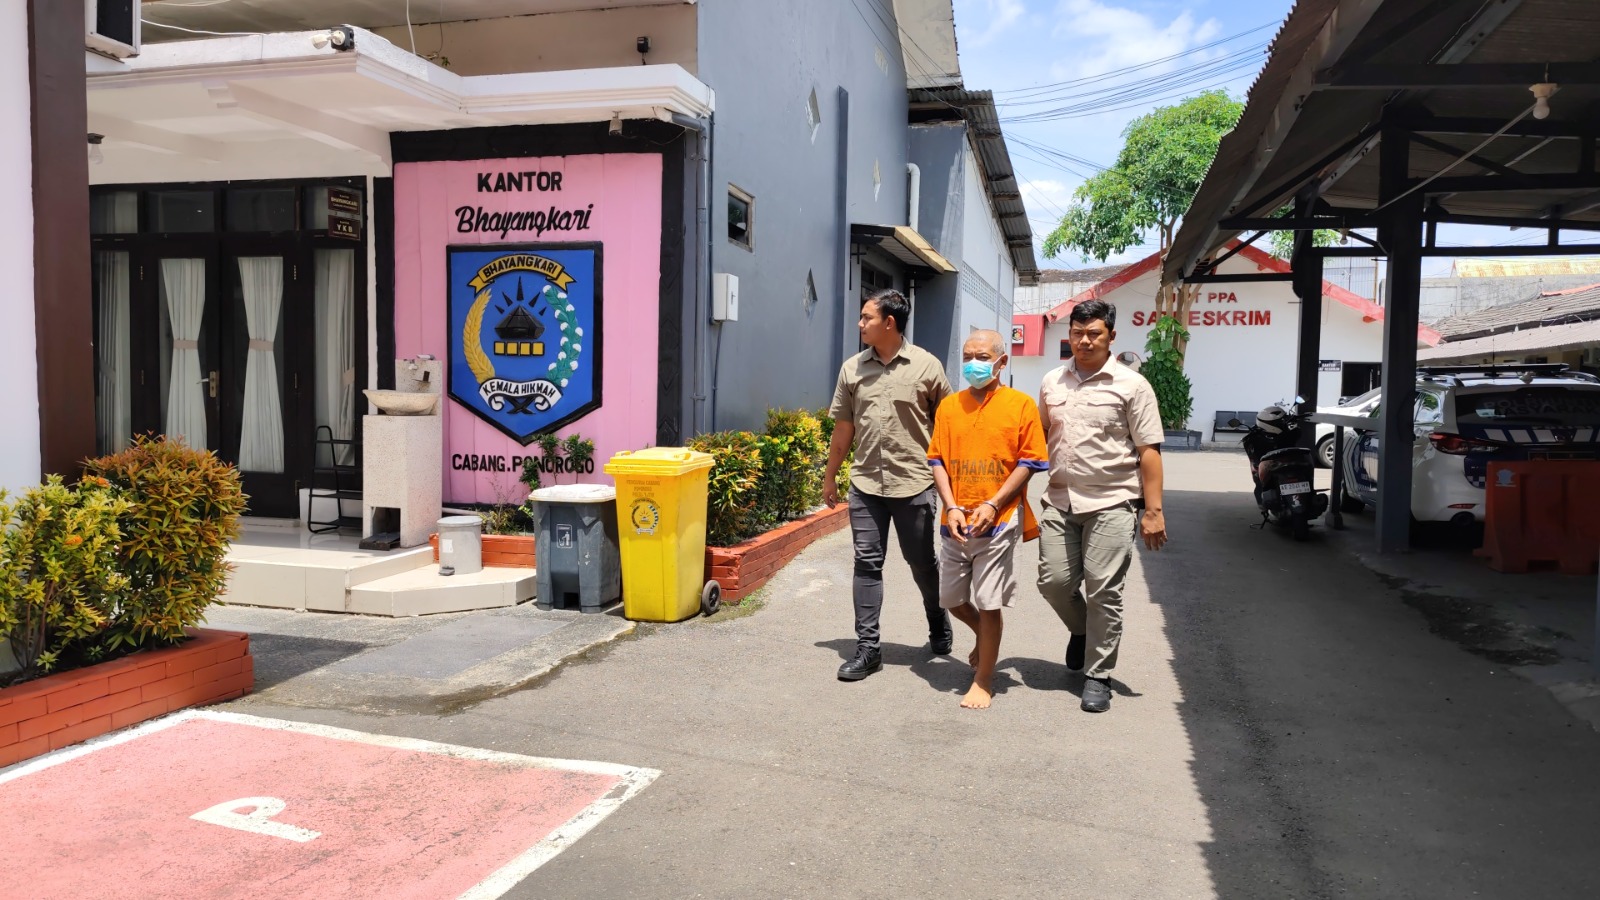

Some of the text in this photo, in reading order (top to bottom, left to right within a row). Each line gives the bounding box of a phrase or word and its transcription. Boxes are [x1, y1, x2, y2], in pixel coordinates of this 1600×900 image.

[477, 171, 563, 193] KANTOR
[454, 203, 594, 239] Bhayangkari
[482, 256, 558, 278] BHAYANGKARI
[1207, 292, 1238, 303] PPA
[1131, 310, 1271, 326] SAESKRIM
[482, 381, 556, 398] KEMALA HIKMAH
[188, 796, 322, 843] P
